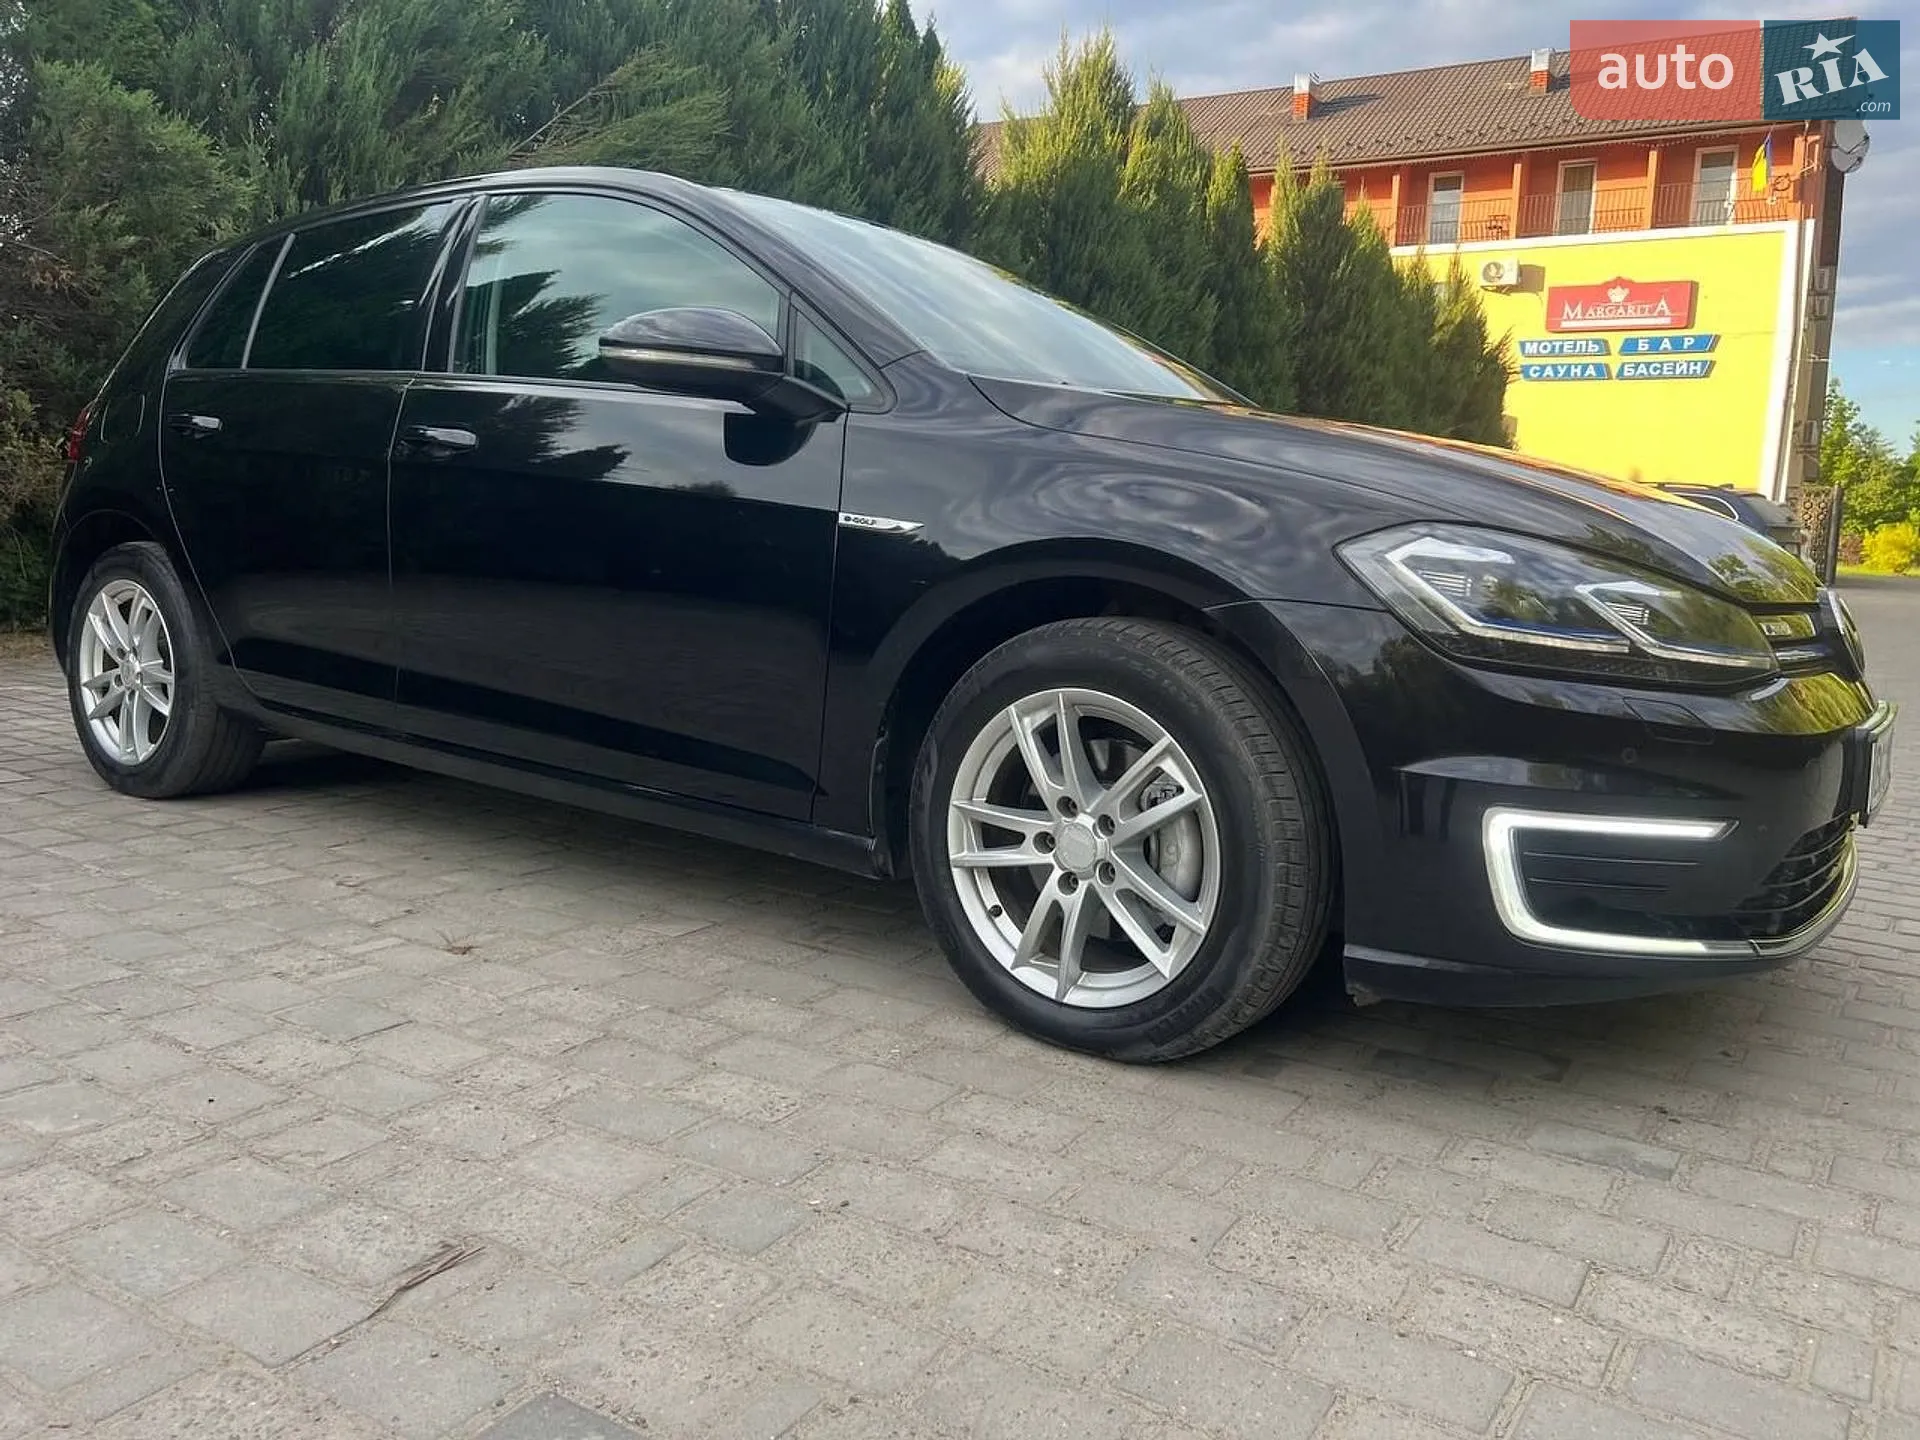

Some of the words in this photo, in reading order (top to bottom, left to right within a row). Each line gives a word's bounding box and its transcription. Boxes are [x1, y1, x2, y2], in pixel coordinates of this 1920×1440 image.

[1525, 341, 1600, 354] МОТЕЛЬ
[1637, 337, 1695, 351] БАР
[1529, 364, 1597, 377] САУНА
[1623, 361, 1702, 376] БАСЕЙН
